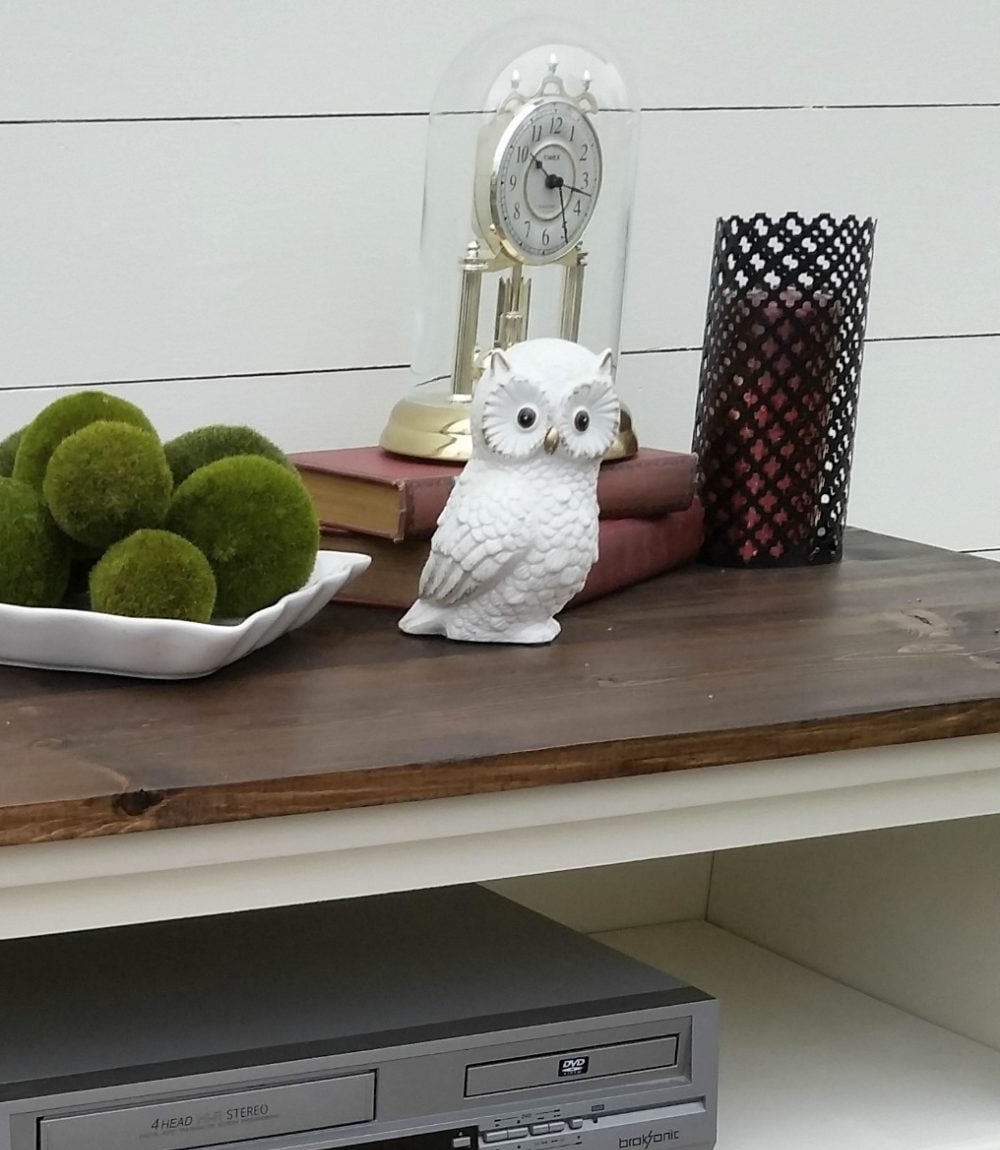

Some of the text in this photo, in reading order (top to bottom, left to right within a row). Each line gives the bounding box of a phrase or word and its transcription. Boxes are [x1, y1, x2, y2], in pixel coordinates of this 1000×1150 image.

[531, 125, 543, 142] 11
[549, 116, 563, 135] 12
[516, 146, 529, 164] 10
[579, 144, 588, 162] 2
[509, 174, 517, 191] 9
[581, 172, 589, 190] 3
[513, 202, 521, 220] 8
[573, 199, 581, 216] 4
[524, 221, 531, 238] 7
[542, 228, 549, 245] 6
[562, 1058, 586, 1068] DVD
[151, 1118, 159, 1130] 4
[160, 1115, 193, 1130] HEAD
[226, 1103, 269, 1120] STEREO
